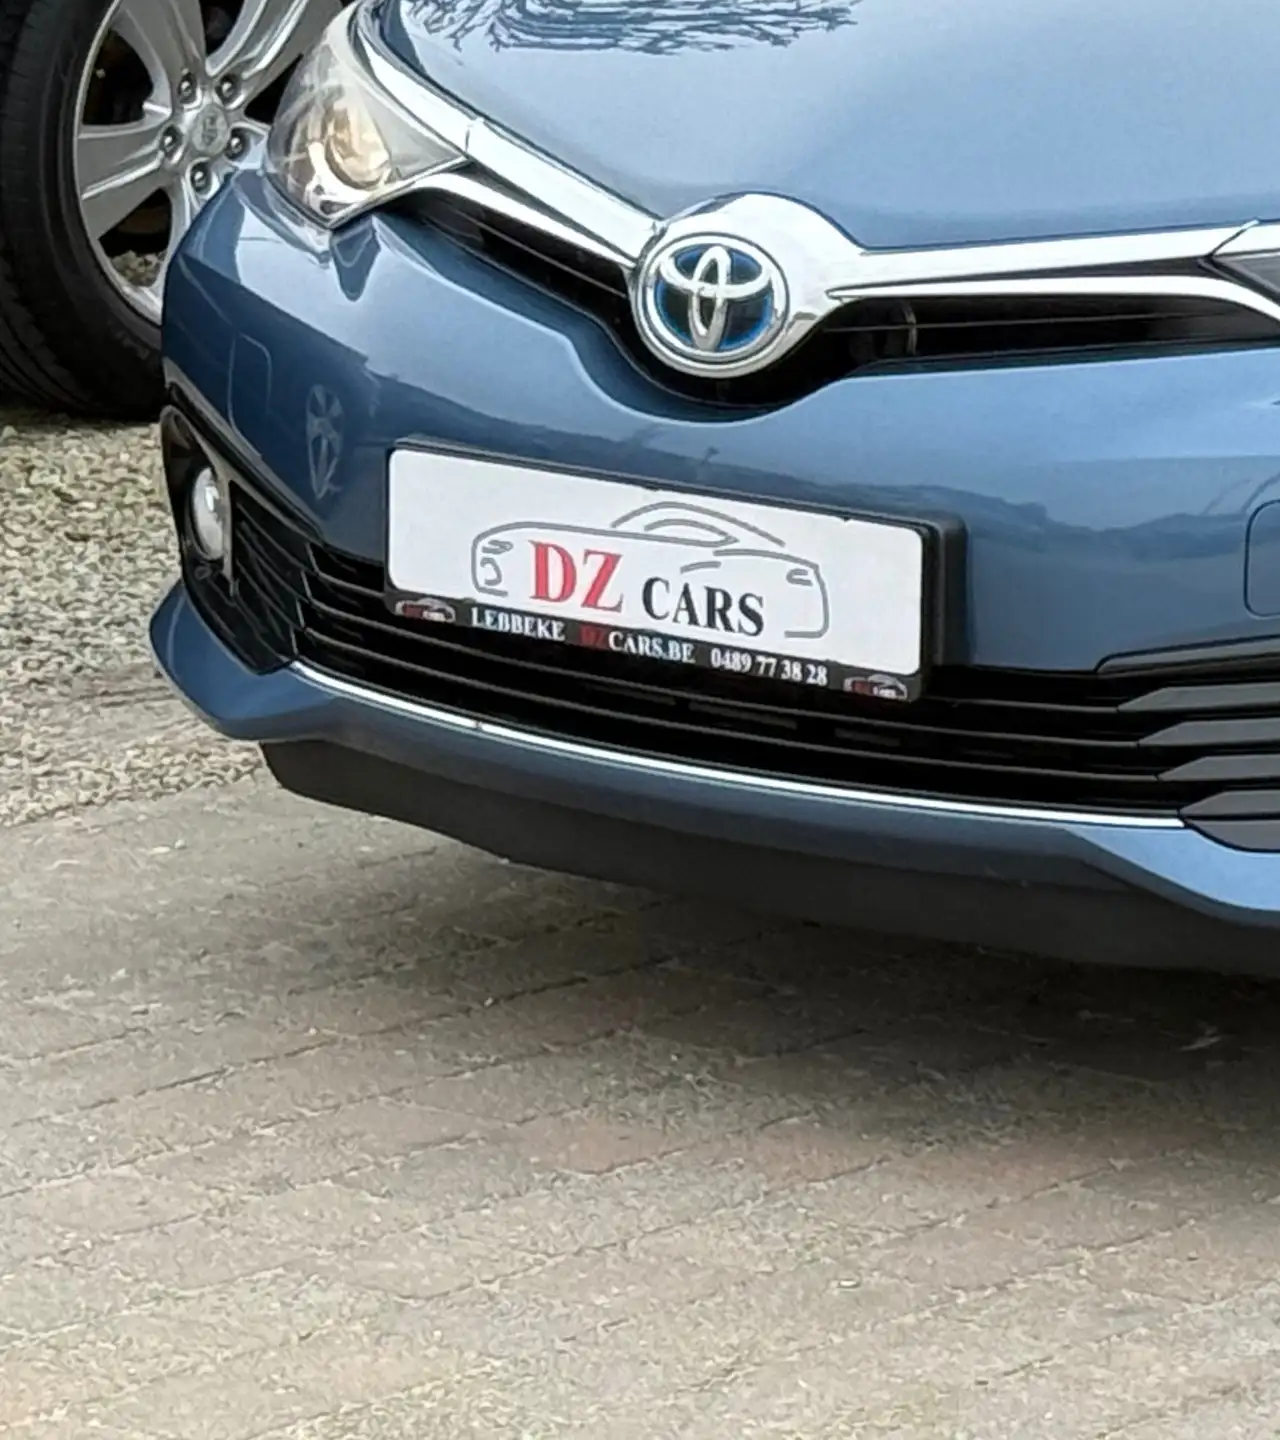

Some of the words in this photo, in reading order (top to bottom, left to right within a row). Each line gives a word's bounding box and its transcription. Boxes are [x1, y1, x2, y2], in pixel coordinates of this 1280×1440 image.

[528, 539, 624, 613] DZ
[642, 576, 765, 638] CARS
[470, 606, 567, 642] LEBBEKE
[711, 647, 752, 673] 0489
[755, 655, 778, 677] 77
[780, 660, 802, 681] 38
[806, 664, 829, 686] 28
